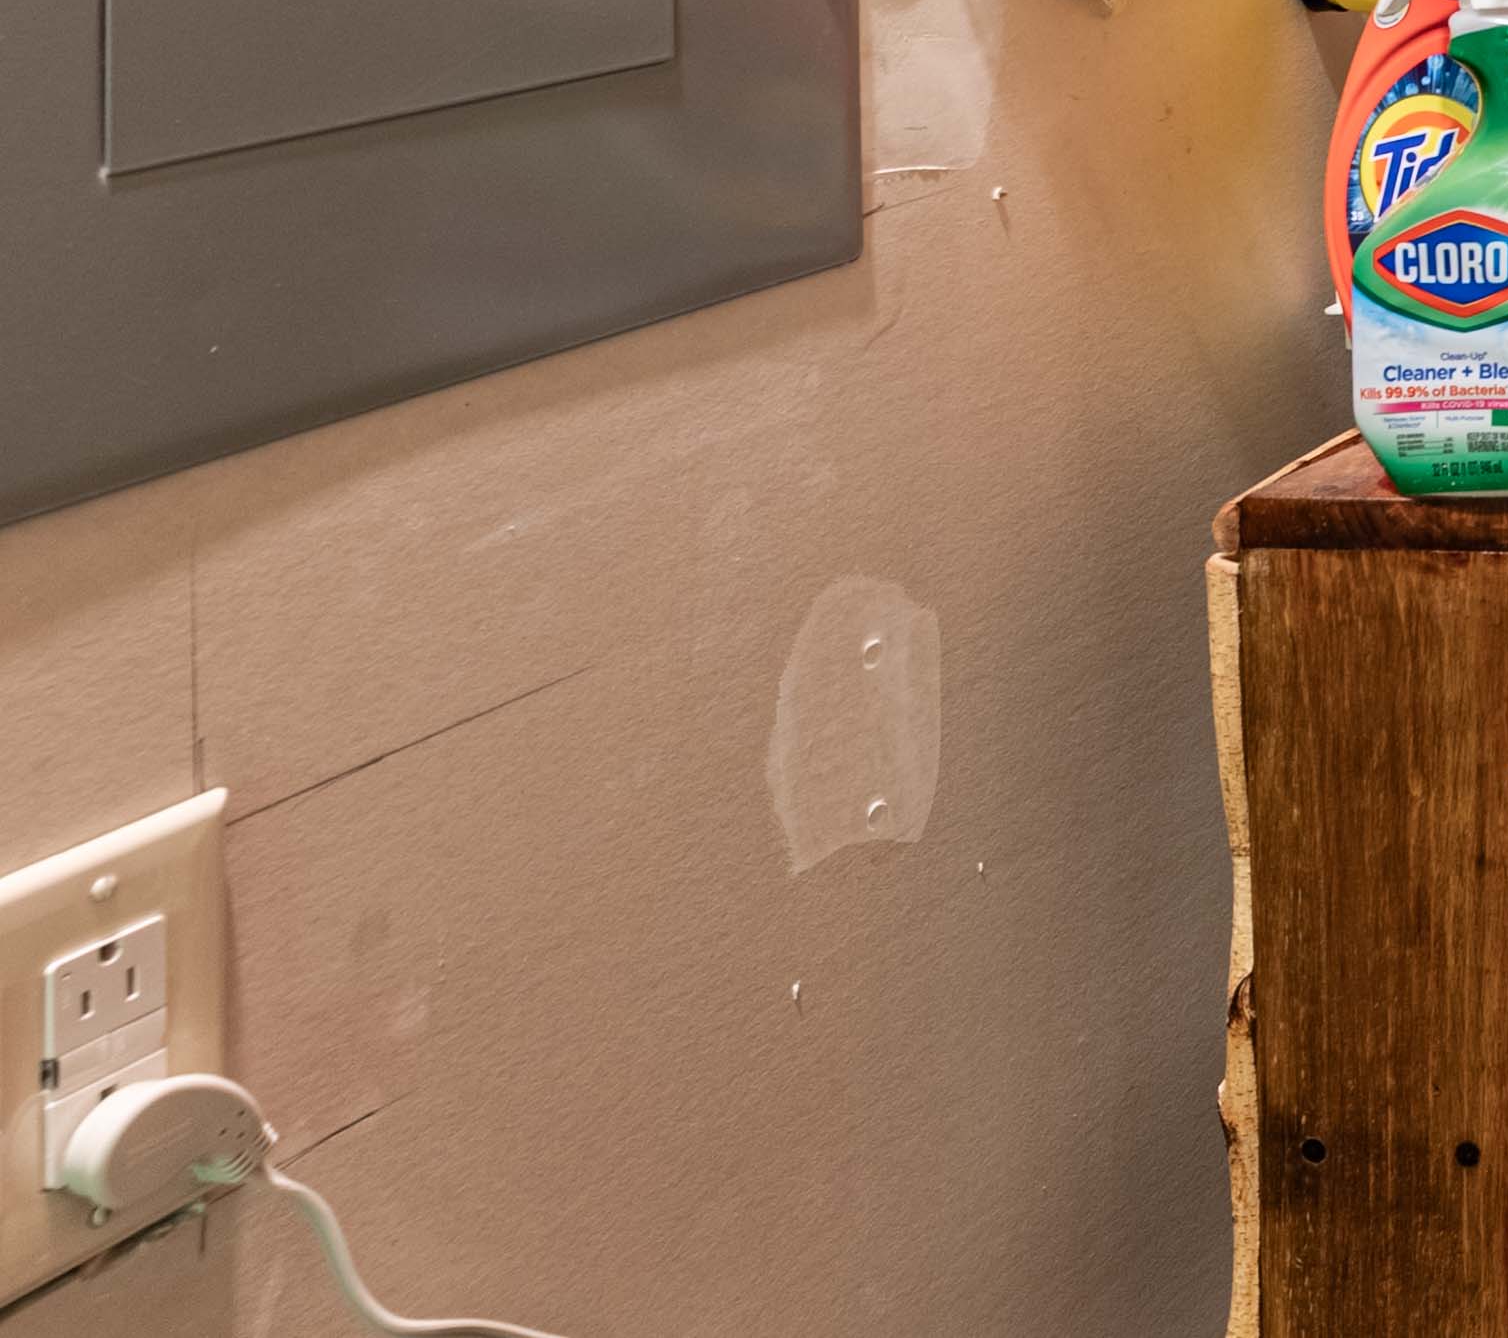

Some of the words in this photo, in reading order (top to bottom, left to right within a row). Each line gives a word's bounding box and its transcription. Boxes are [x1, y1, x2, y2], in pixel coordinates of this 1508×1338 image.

[1383, 365, 1457, 382] Cleaner
[1462, 368, 1473, 378] +
[1360, 388, 1381, 400] Kills
[1385, 386, 1429, 399] 99.9%
[1432, 385, 1446, 398] of
